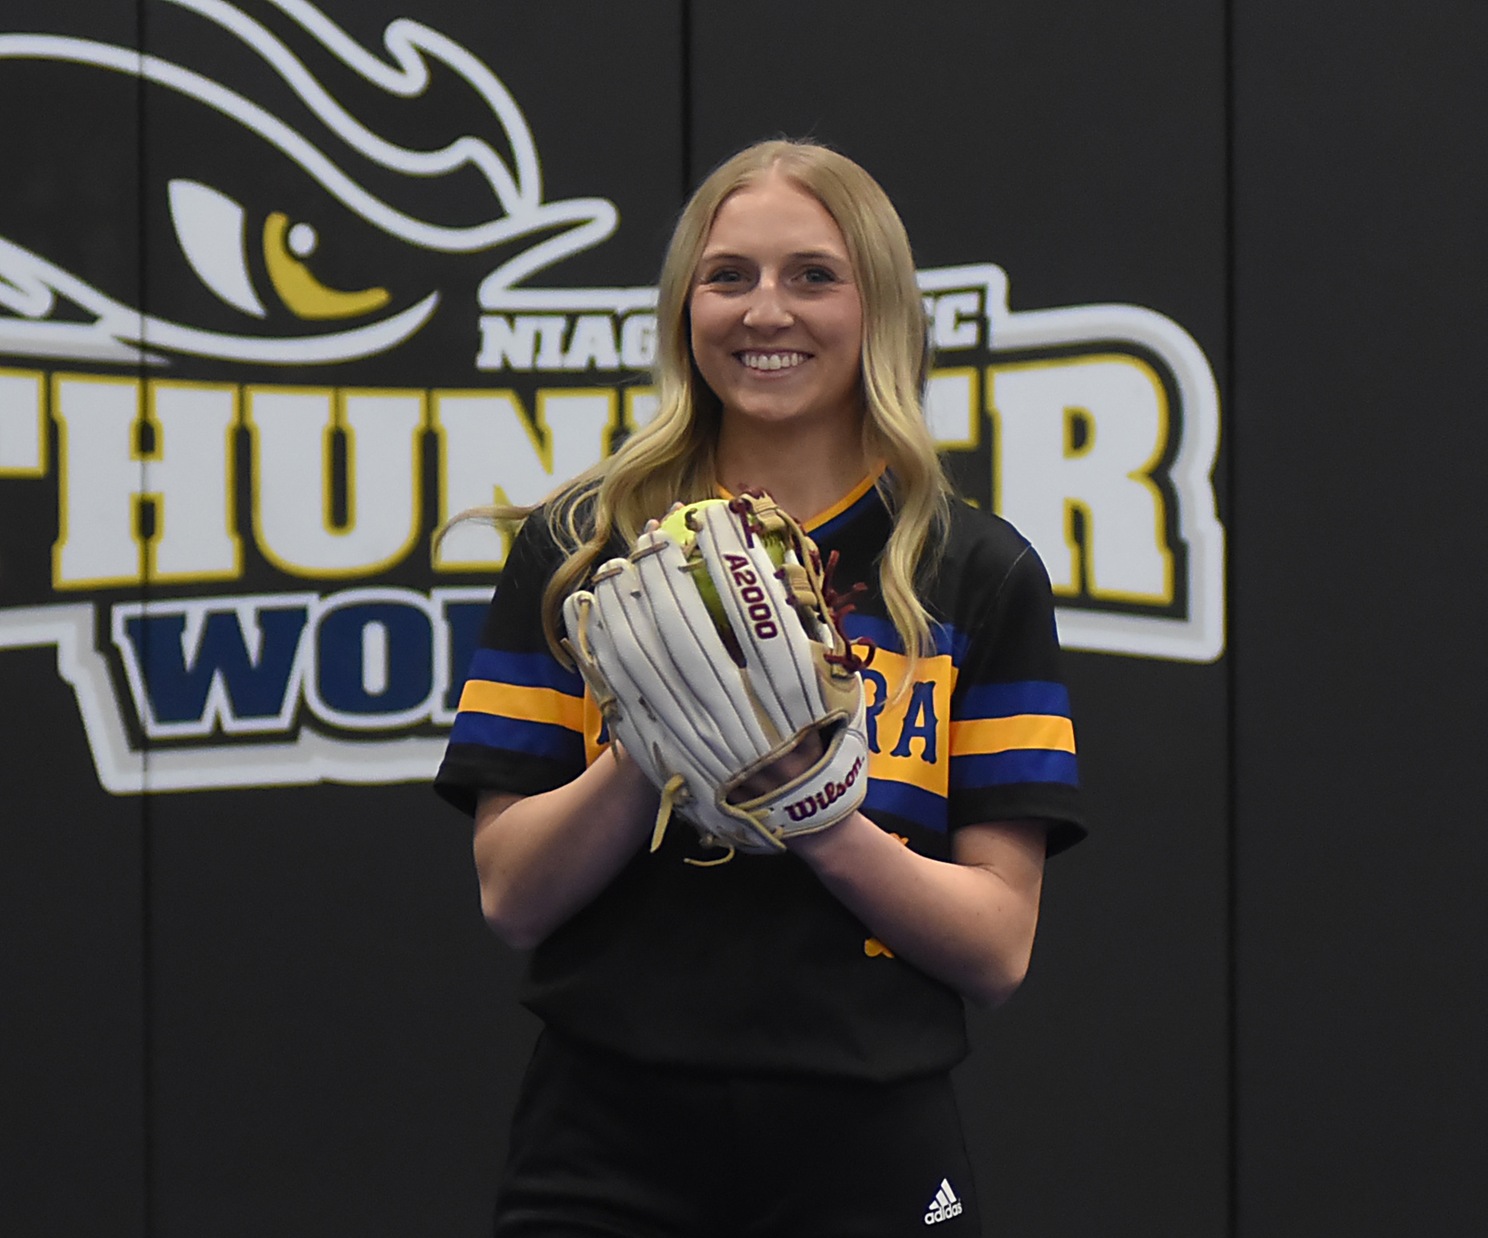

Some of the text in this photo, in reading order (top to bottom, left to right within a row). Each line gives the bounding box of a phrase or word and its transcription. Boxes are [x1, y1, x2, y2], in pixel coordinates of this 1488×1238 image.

[476, 315, 658, 370] NIAG
[723, 553, 779, 641] A2000
[784, 756, 862, 822] Wilson
[924, 1202, 962, 1225] adidas
